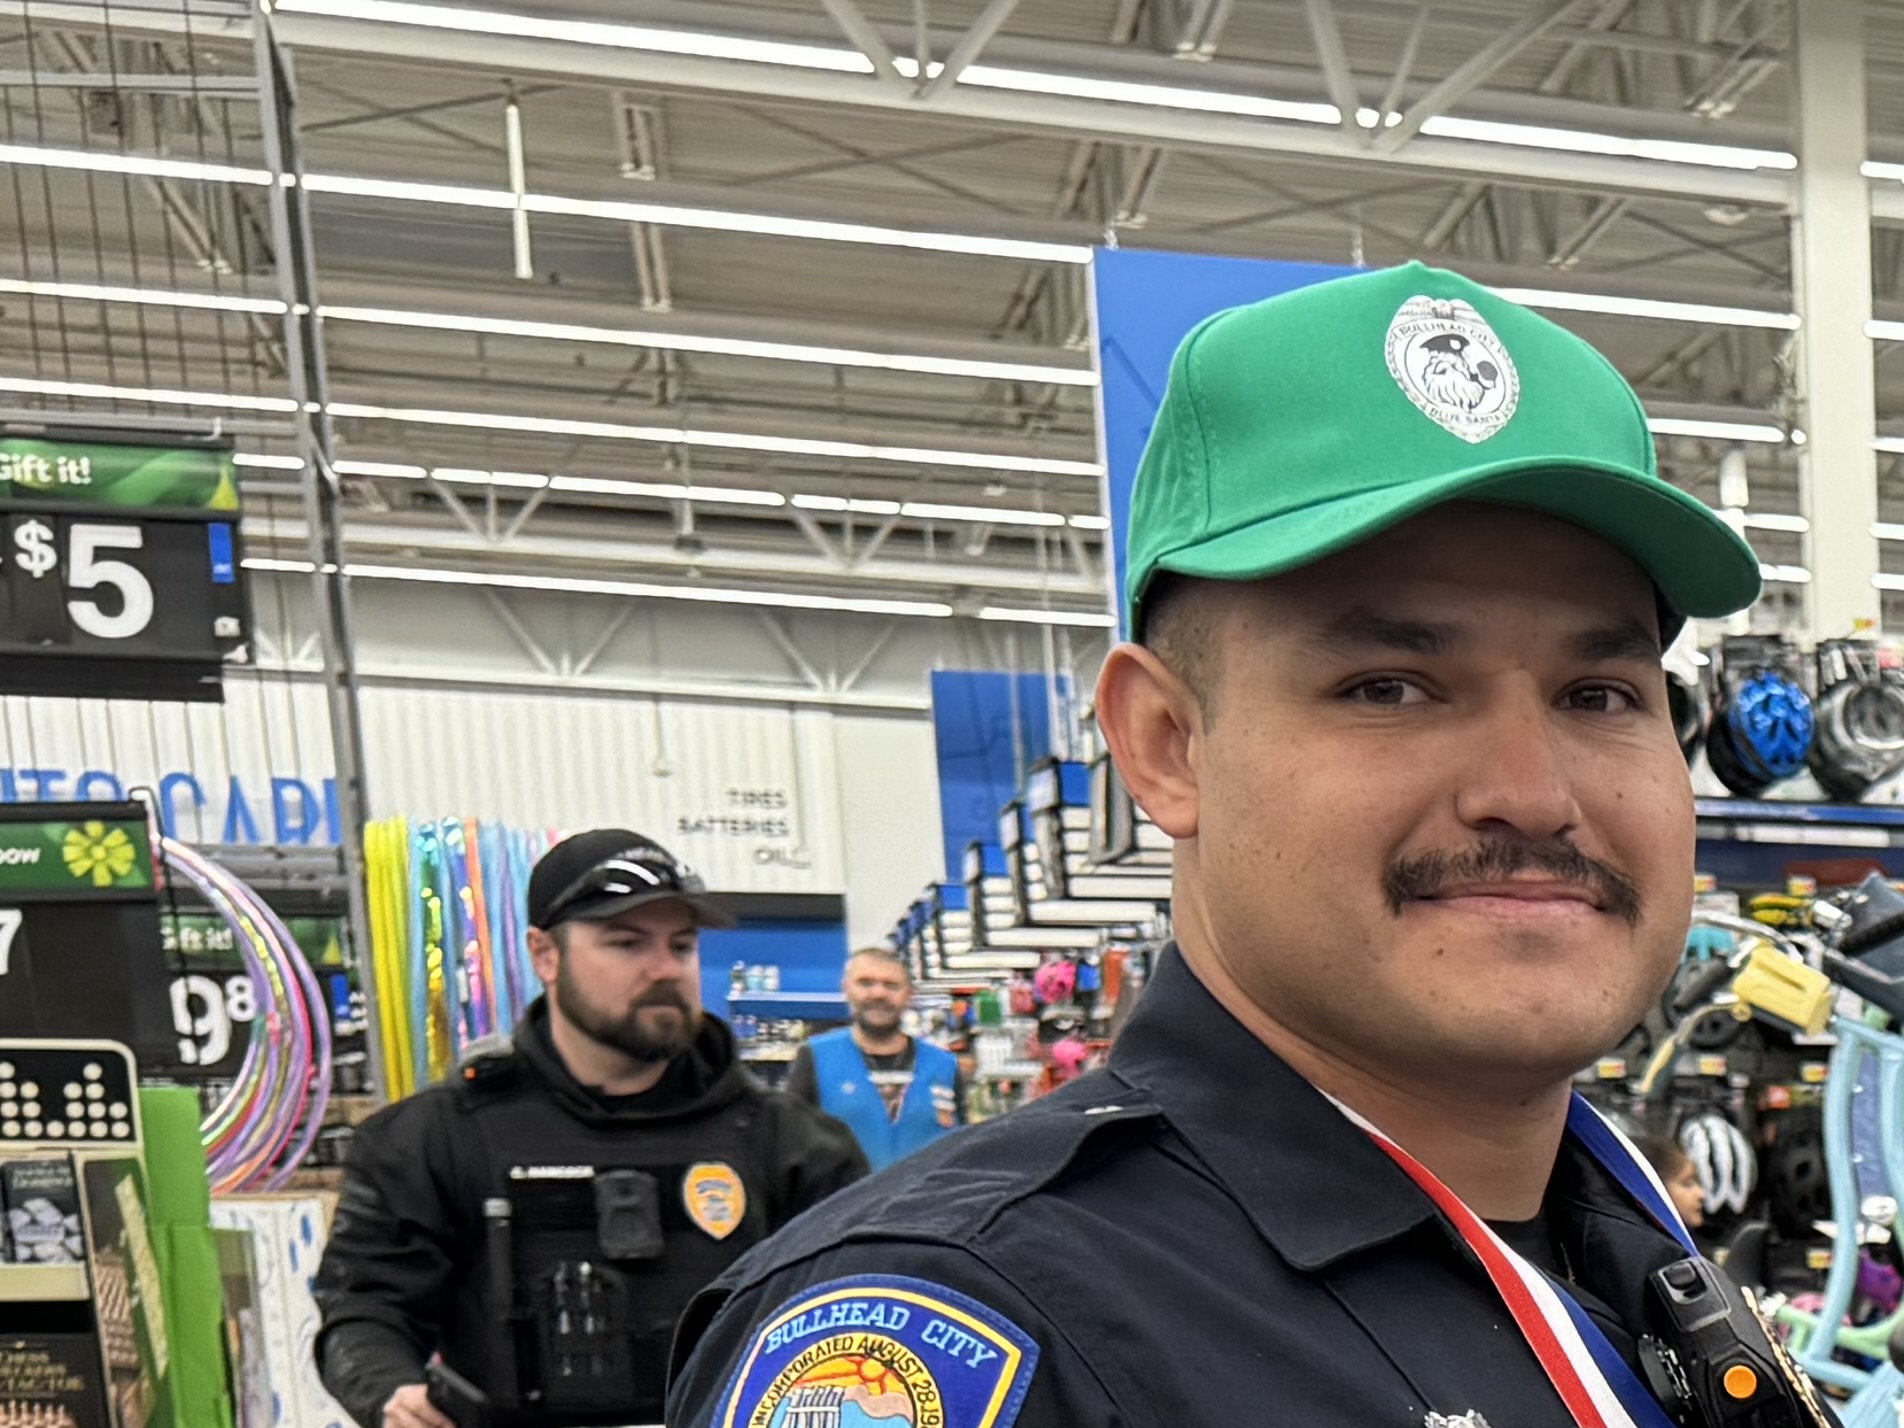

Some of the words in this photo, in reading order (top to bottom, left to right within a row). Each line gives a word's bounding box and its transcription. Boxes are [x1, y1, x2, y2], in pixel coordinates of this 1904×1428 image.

[57, 456, 91, 485] it!
[14, 519, 153, 639] $5
[727, 788, 787, 809] TIRES
[678, 817, 790, 837] BATTERIES
[764, 1302, 910, 1354] BULLHEAD
[921, 1318, 998, 1368] CITY
[752, 1336, 854, 1426] INCORPORATED
[857, 1335, 924, 1380] AUGUST
